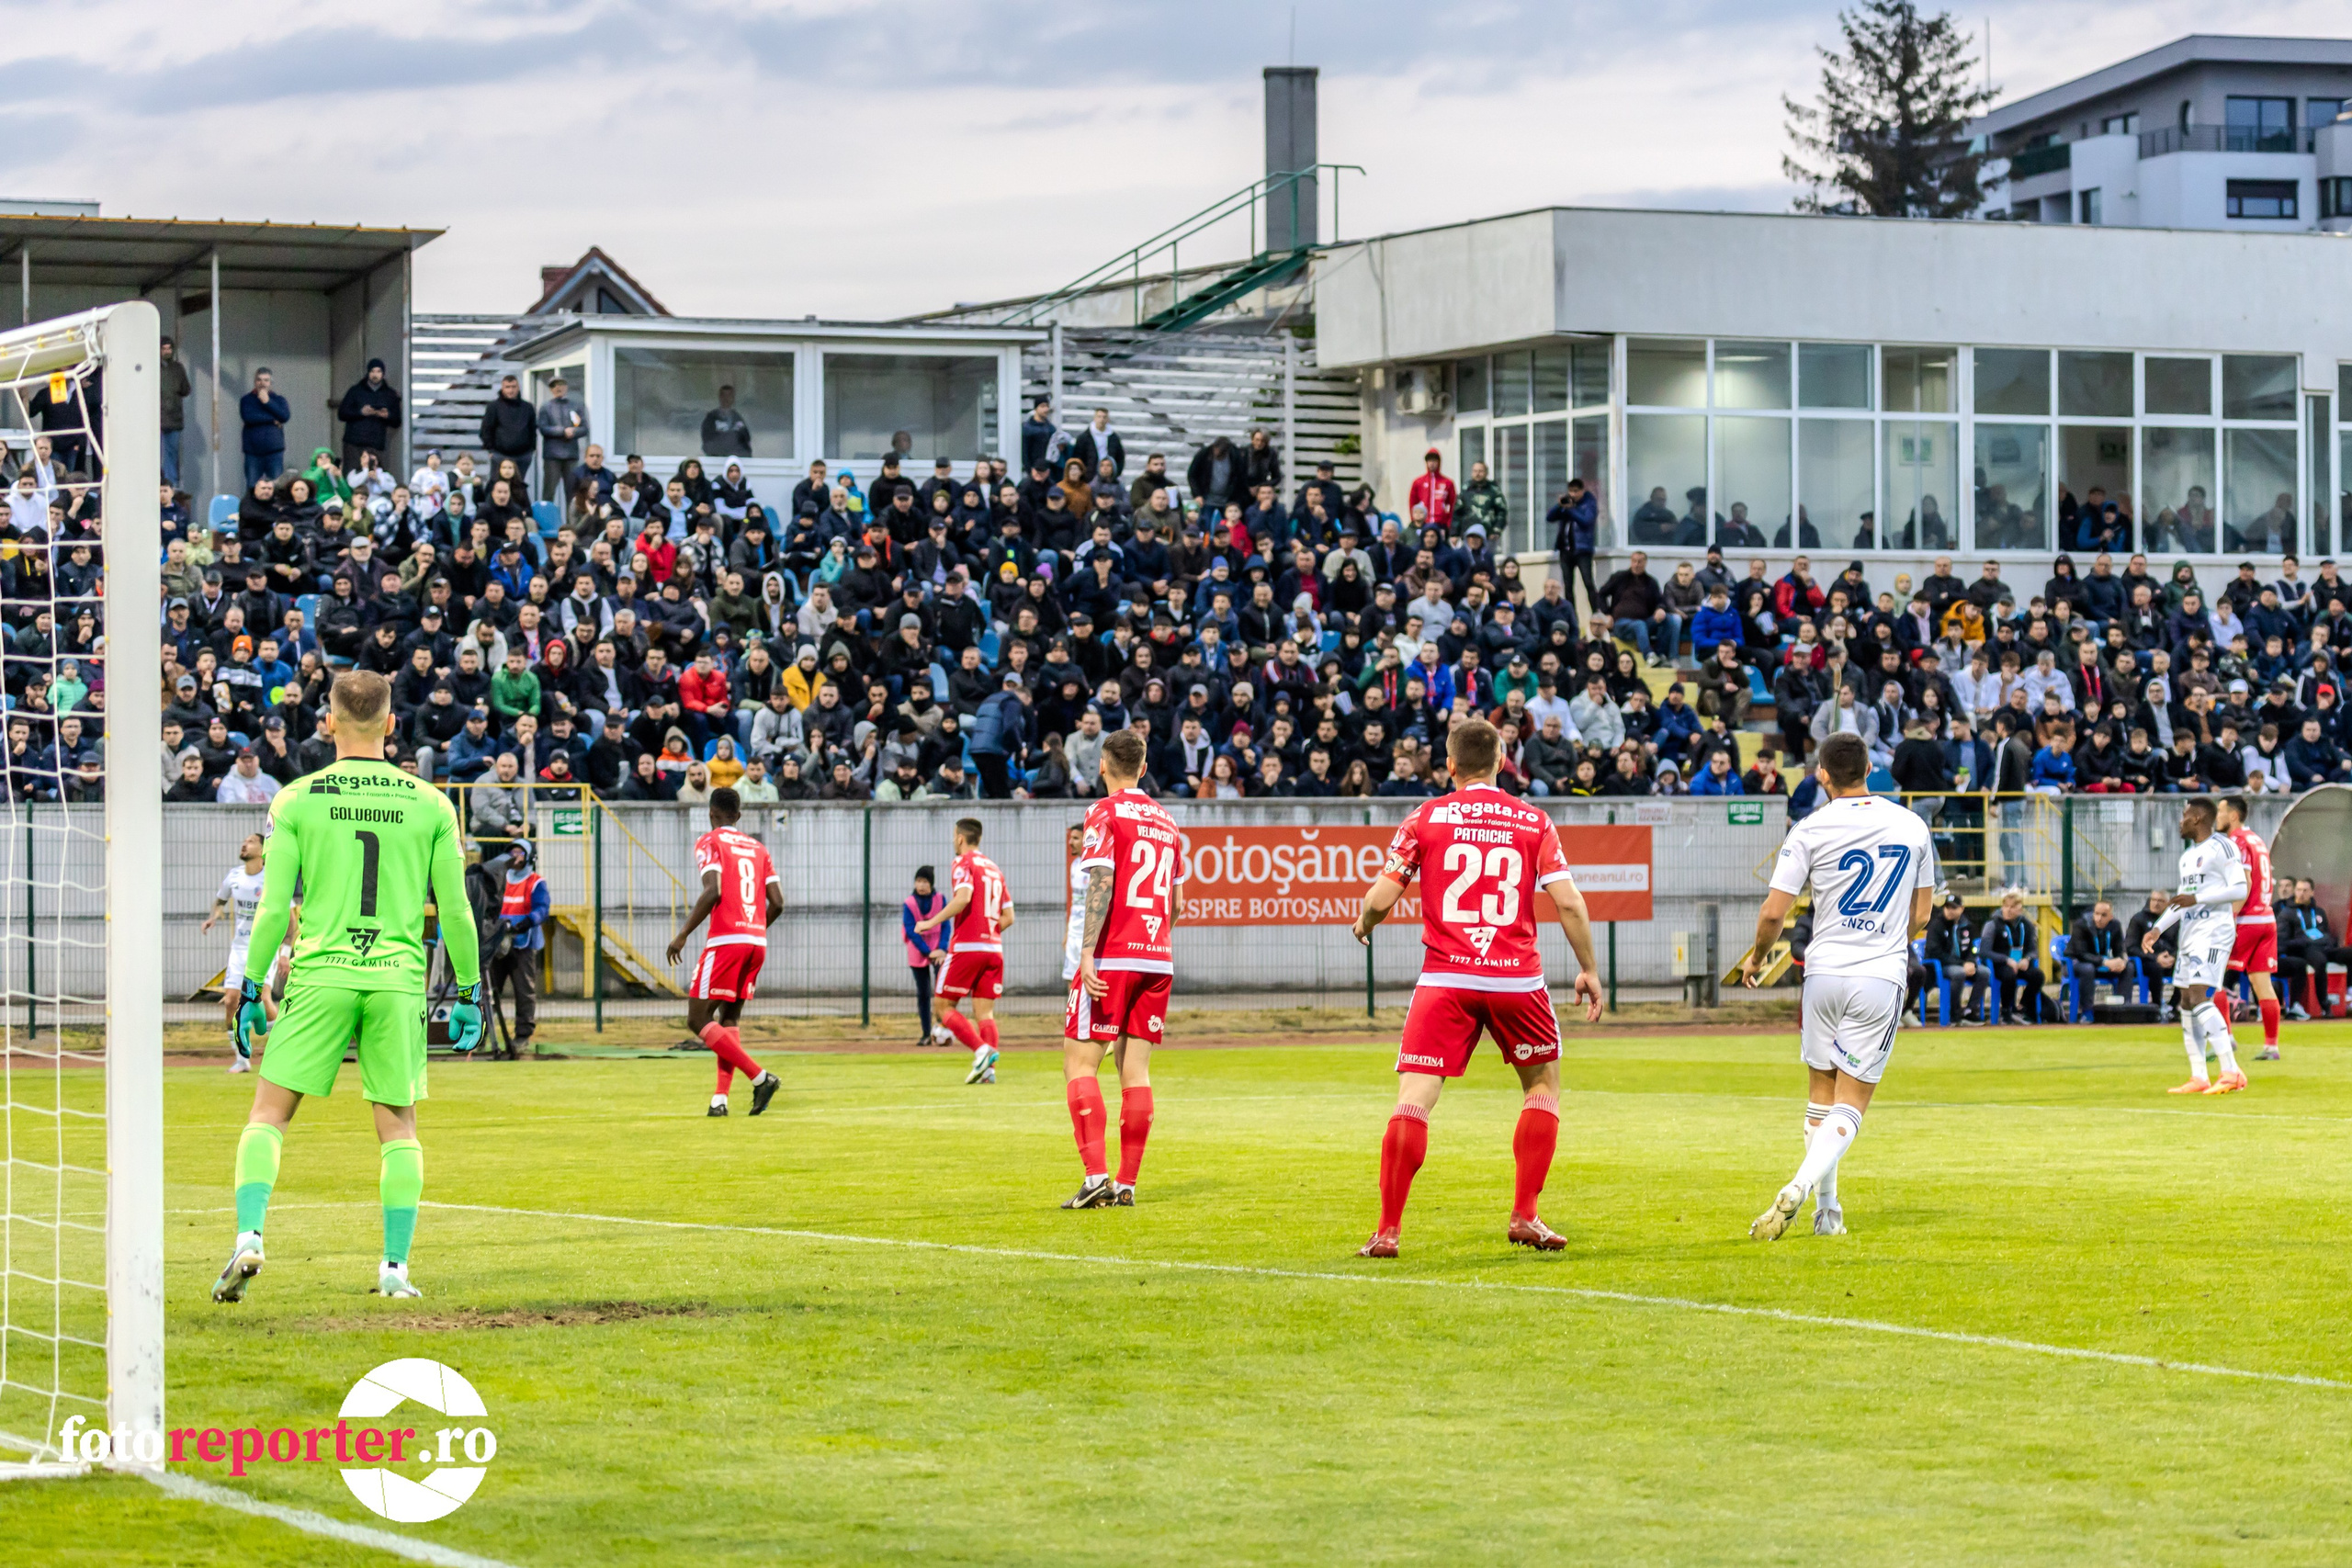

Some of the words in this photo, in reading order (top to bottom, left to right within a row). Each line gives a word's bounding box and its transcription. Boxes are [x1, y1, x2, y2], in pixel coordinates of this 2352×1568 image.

[325, 773, 416, 790] Regata.ro
[330, 806, 403, 824] GOLUBOVIC
[554, 812, 589, 824] IESIR
[1447, 801, 1539, 823] Regata.ro
[1453, 827, 1514, 845] PATRICHE
[1515, 823, 1540, 834] Parchet
[355, 829, 380, 918] 1
[738, 857, 755, 905] 8
[1125, 840, 1175, 915] 24
[1838, 844, 1911, 917] 27
[2260, 854, 2271, 894] 9
[1442, 842, 1523, 927] 23
[1127, 942, 1144, 951] 7777
[324, 955, 347, 964] 7777
[351, 958, 400, 968] GAMING
[1450, 955, 1471, 964] 7777
[1475, 957, 1520, 967] GAMING
[1401, 1053, 1443, 1067] CARPATINA
